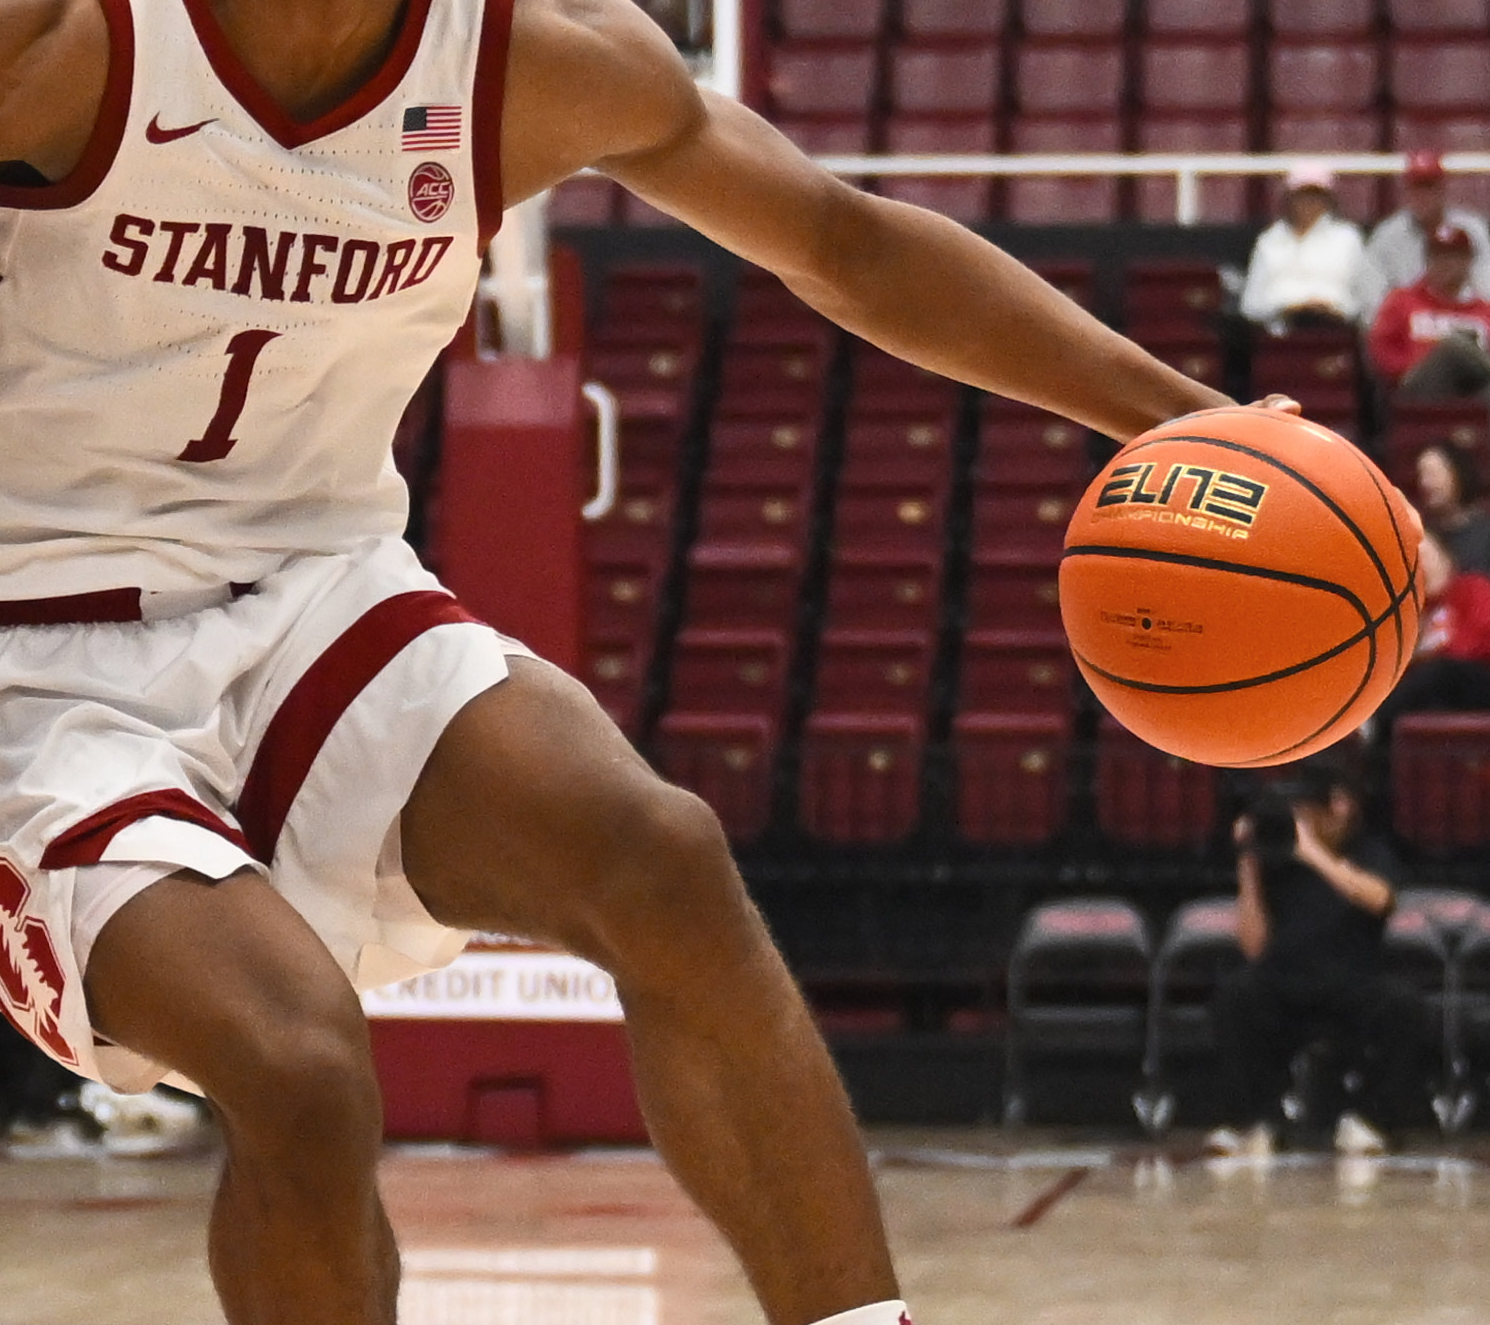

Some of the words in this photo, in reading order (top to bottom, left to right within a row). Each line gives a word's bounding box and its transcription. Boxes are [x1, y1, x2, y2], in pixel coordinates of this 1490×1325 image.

[415, 181, 451, 197] ACC
[101, 213, 455, 305] STANFORD
[176, 329, 284, 463] 1
[1095, 461, 1270, 527] ELITE
[516, 970, 613, 1004] UNIO
